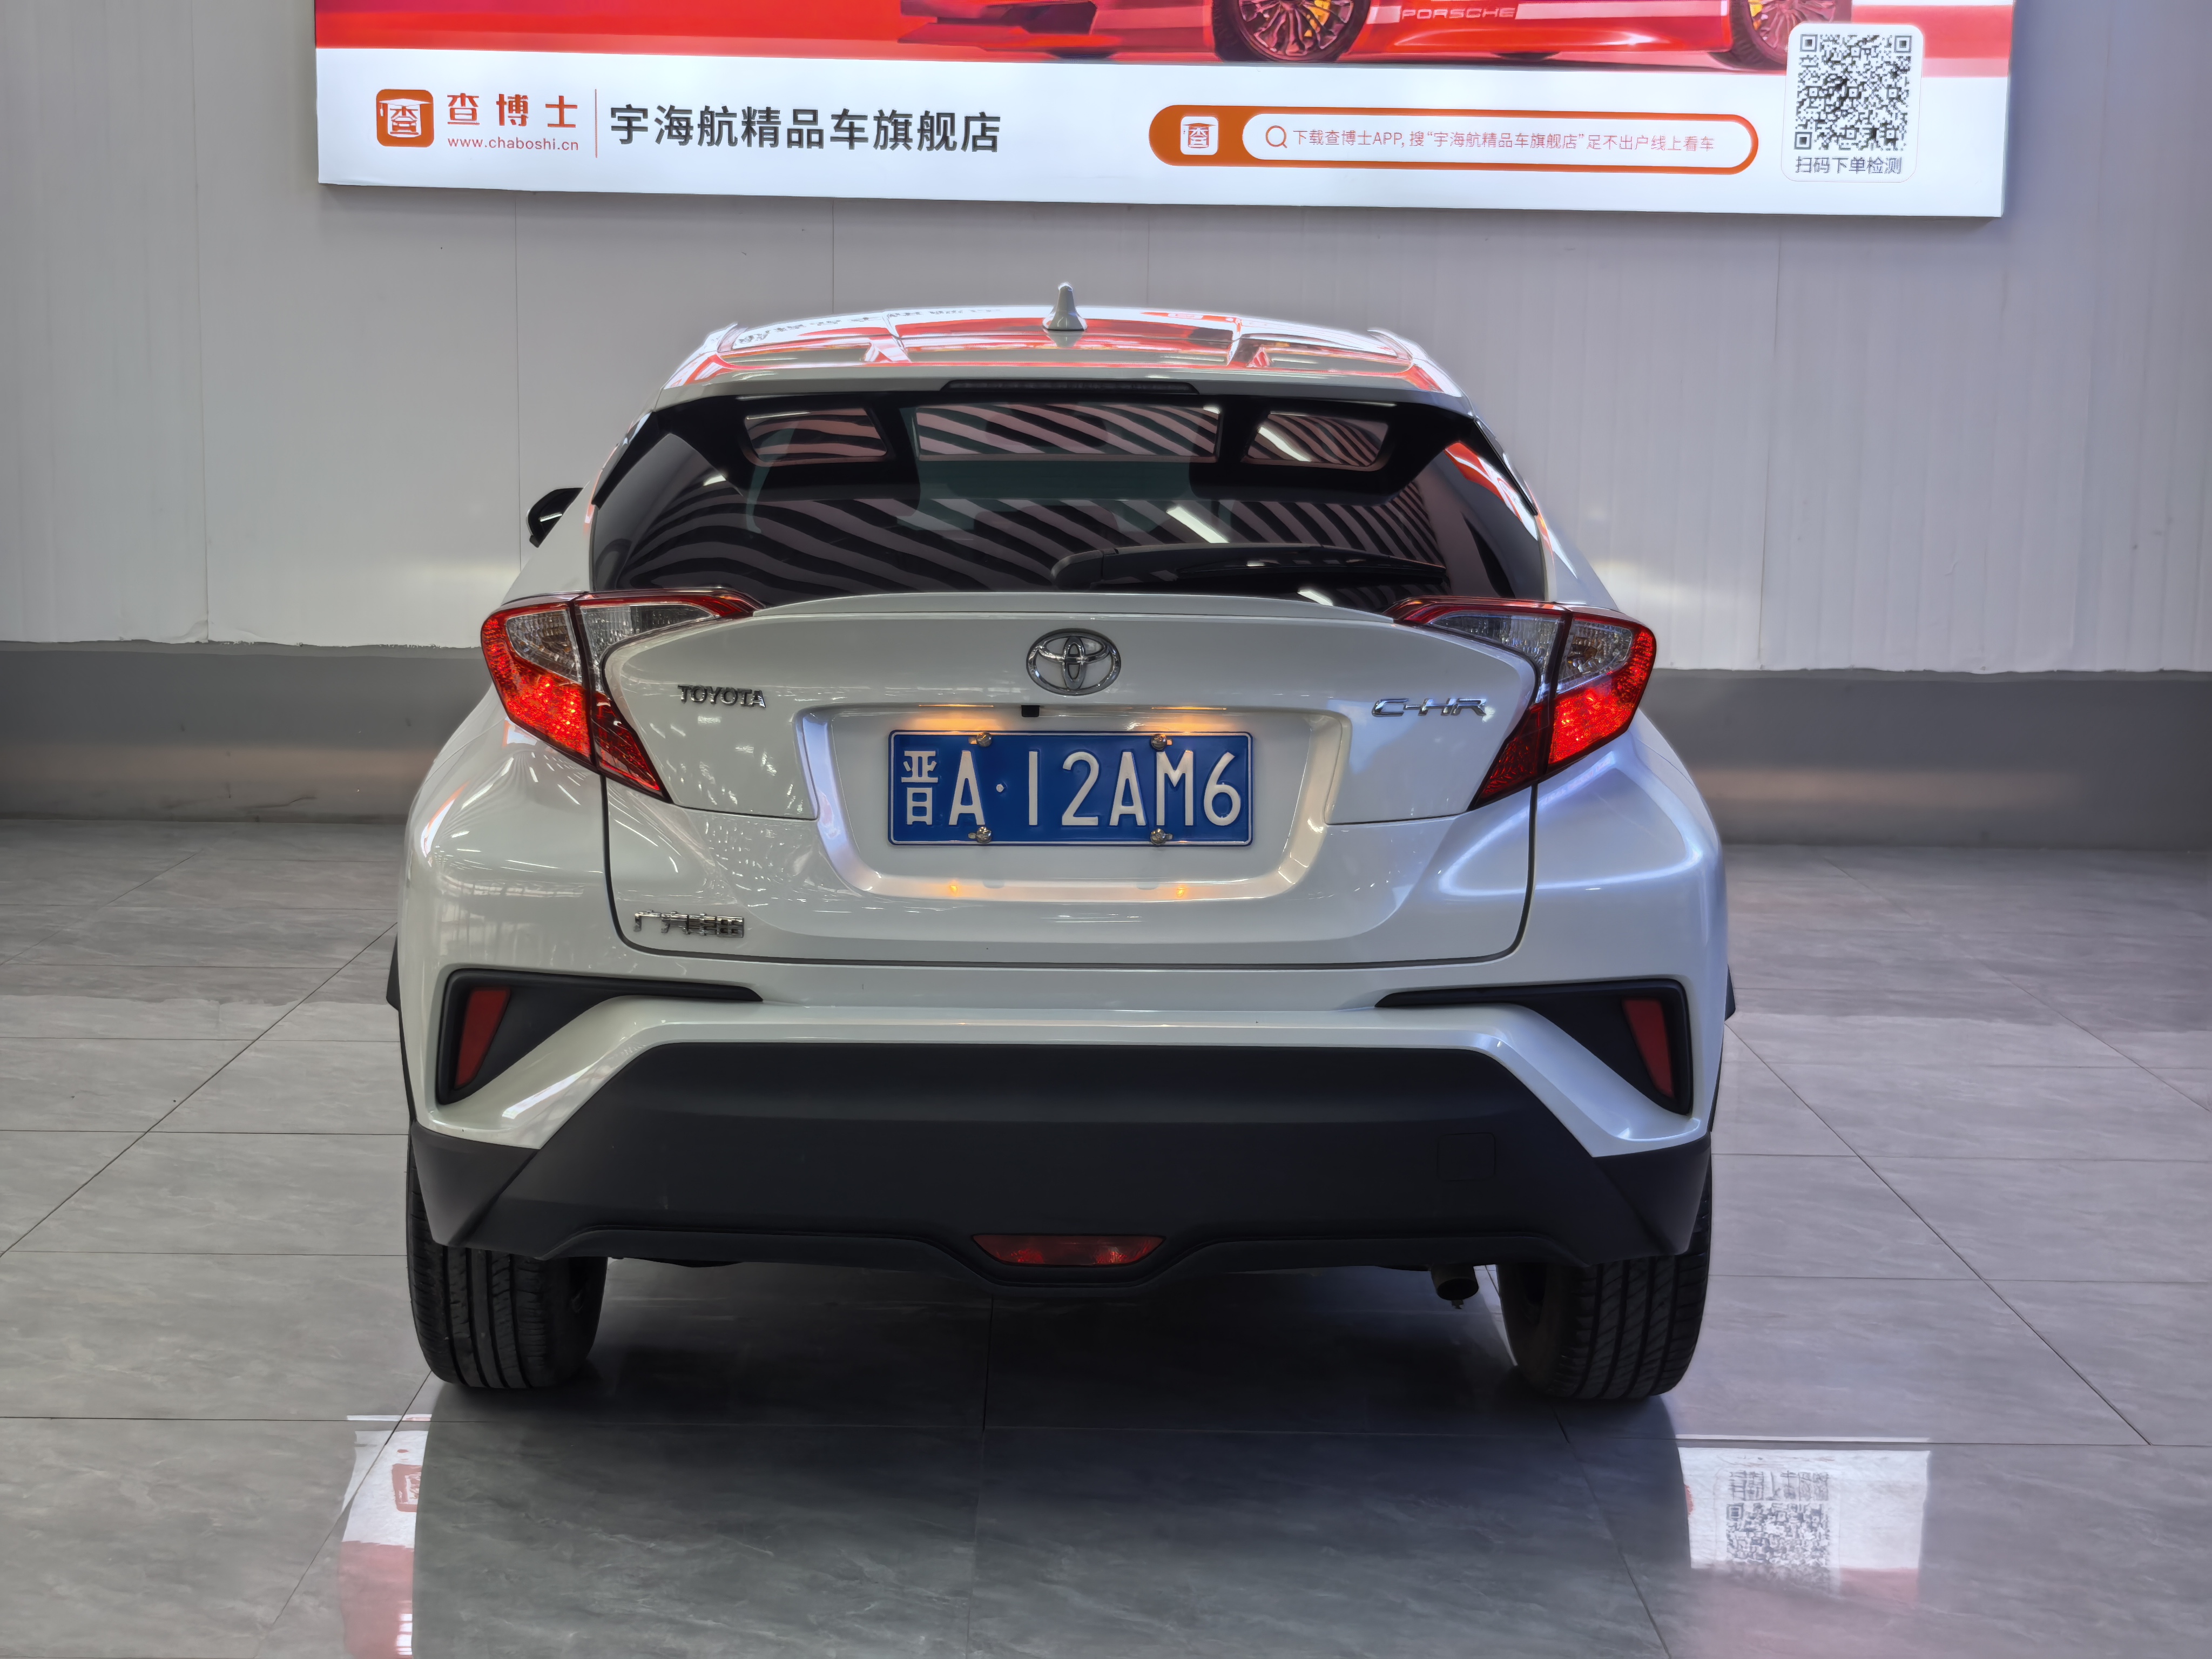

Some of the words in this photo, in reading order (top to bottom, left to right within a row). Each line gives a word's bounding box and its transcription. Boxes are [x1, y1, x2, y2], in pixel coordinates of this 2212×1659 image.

[1401, 6, 1516, 20] PORSCHE
[447, 92, 578, 128] 查博士
[610, 104, 1001, 153] 宇海航精品车旗舰店
[447, 136, 579, 151] www.chaboshi.cn
[1795, 156, 1903, 175] 扫码下单检测
[677, 684, 766, 709] TOYOTA
[1371, 698, 1487, 718] C-HR
